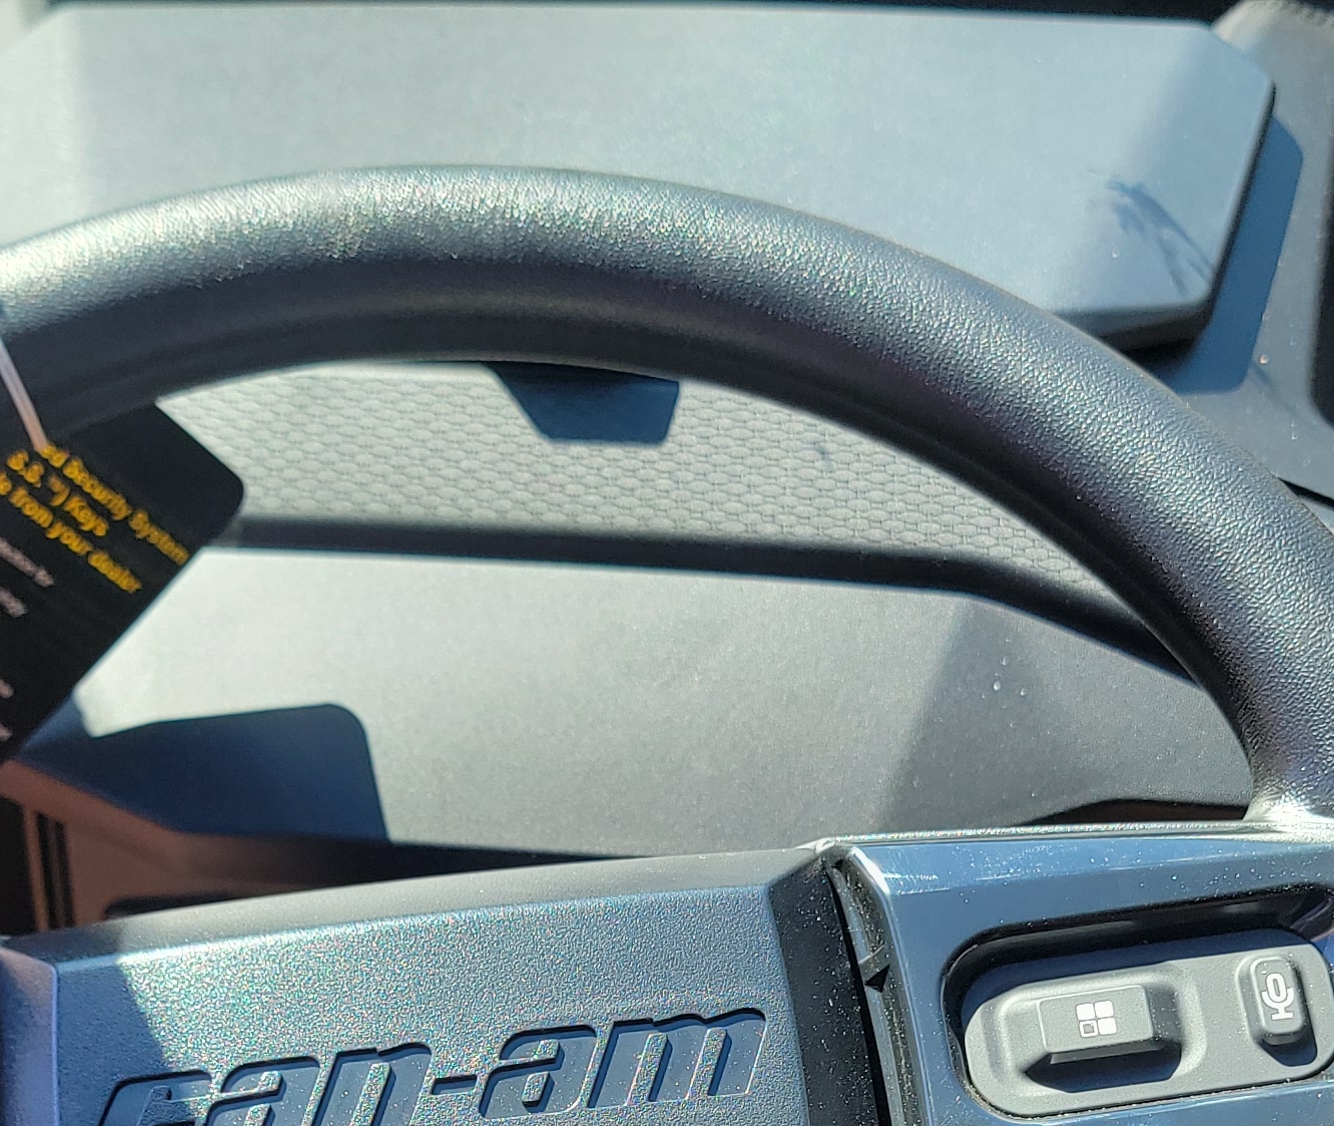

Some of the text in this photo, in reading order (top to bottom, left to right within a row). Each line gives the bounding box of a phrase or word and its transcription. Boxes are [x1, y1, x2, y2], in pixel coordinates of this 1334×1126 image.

[9, 486, 54, 529] from
[46, 520, 94, 556] your
[87, 550, 142, 594] dealer
[63, 457, 132, 521] Security
[129, 508, 189, 566] System
[64, 495, 109, 537] Keys
